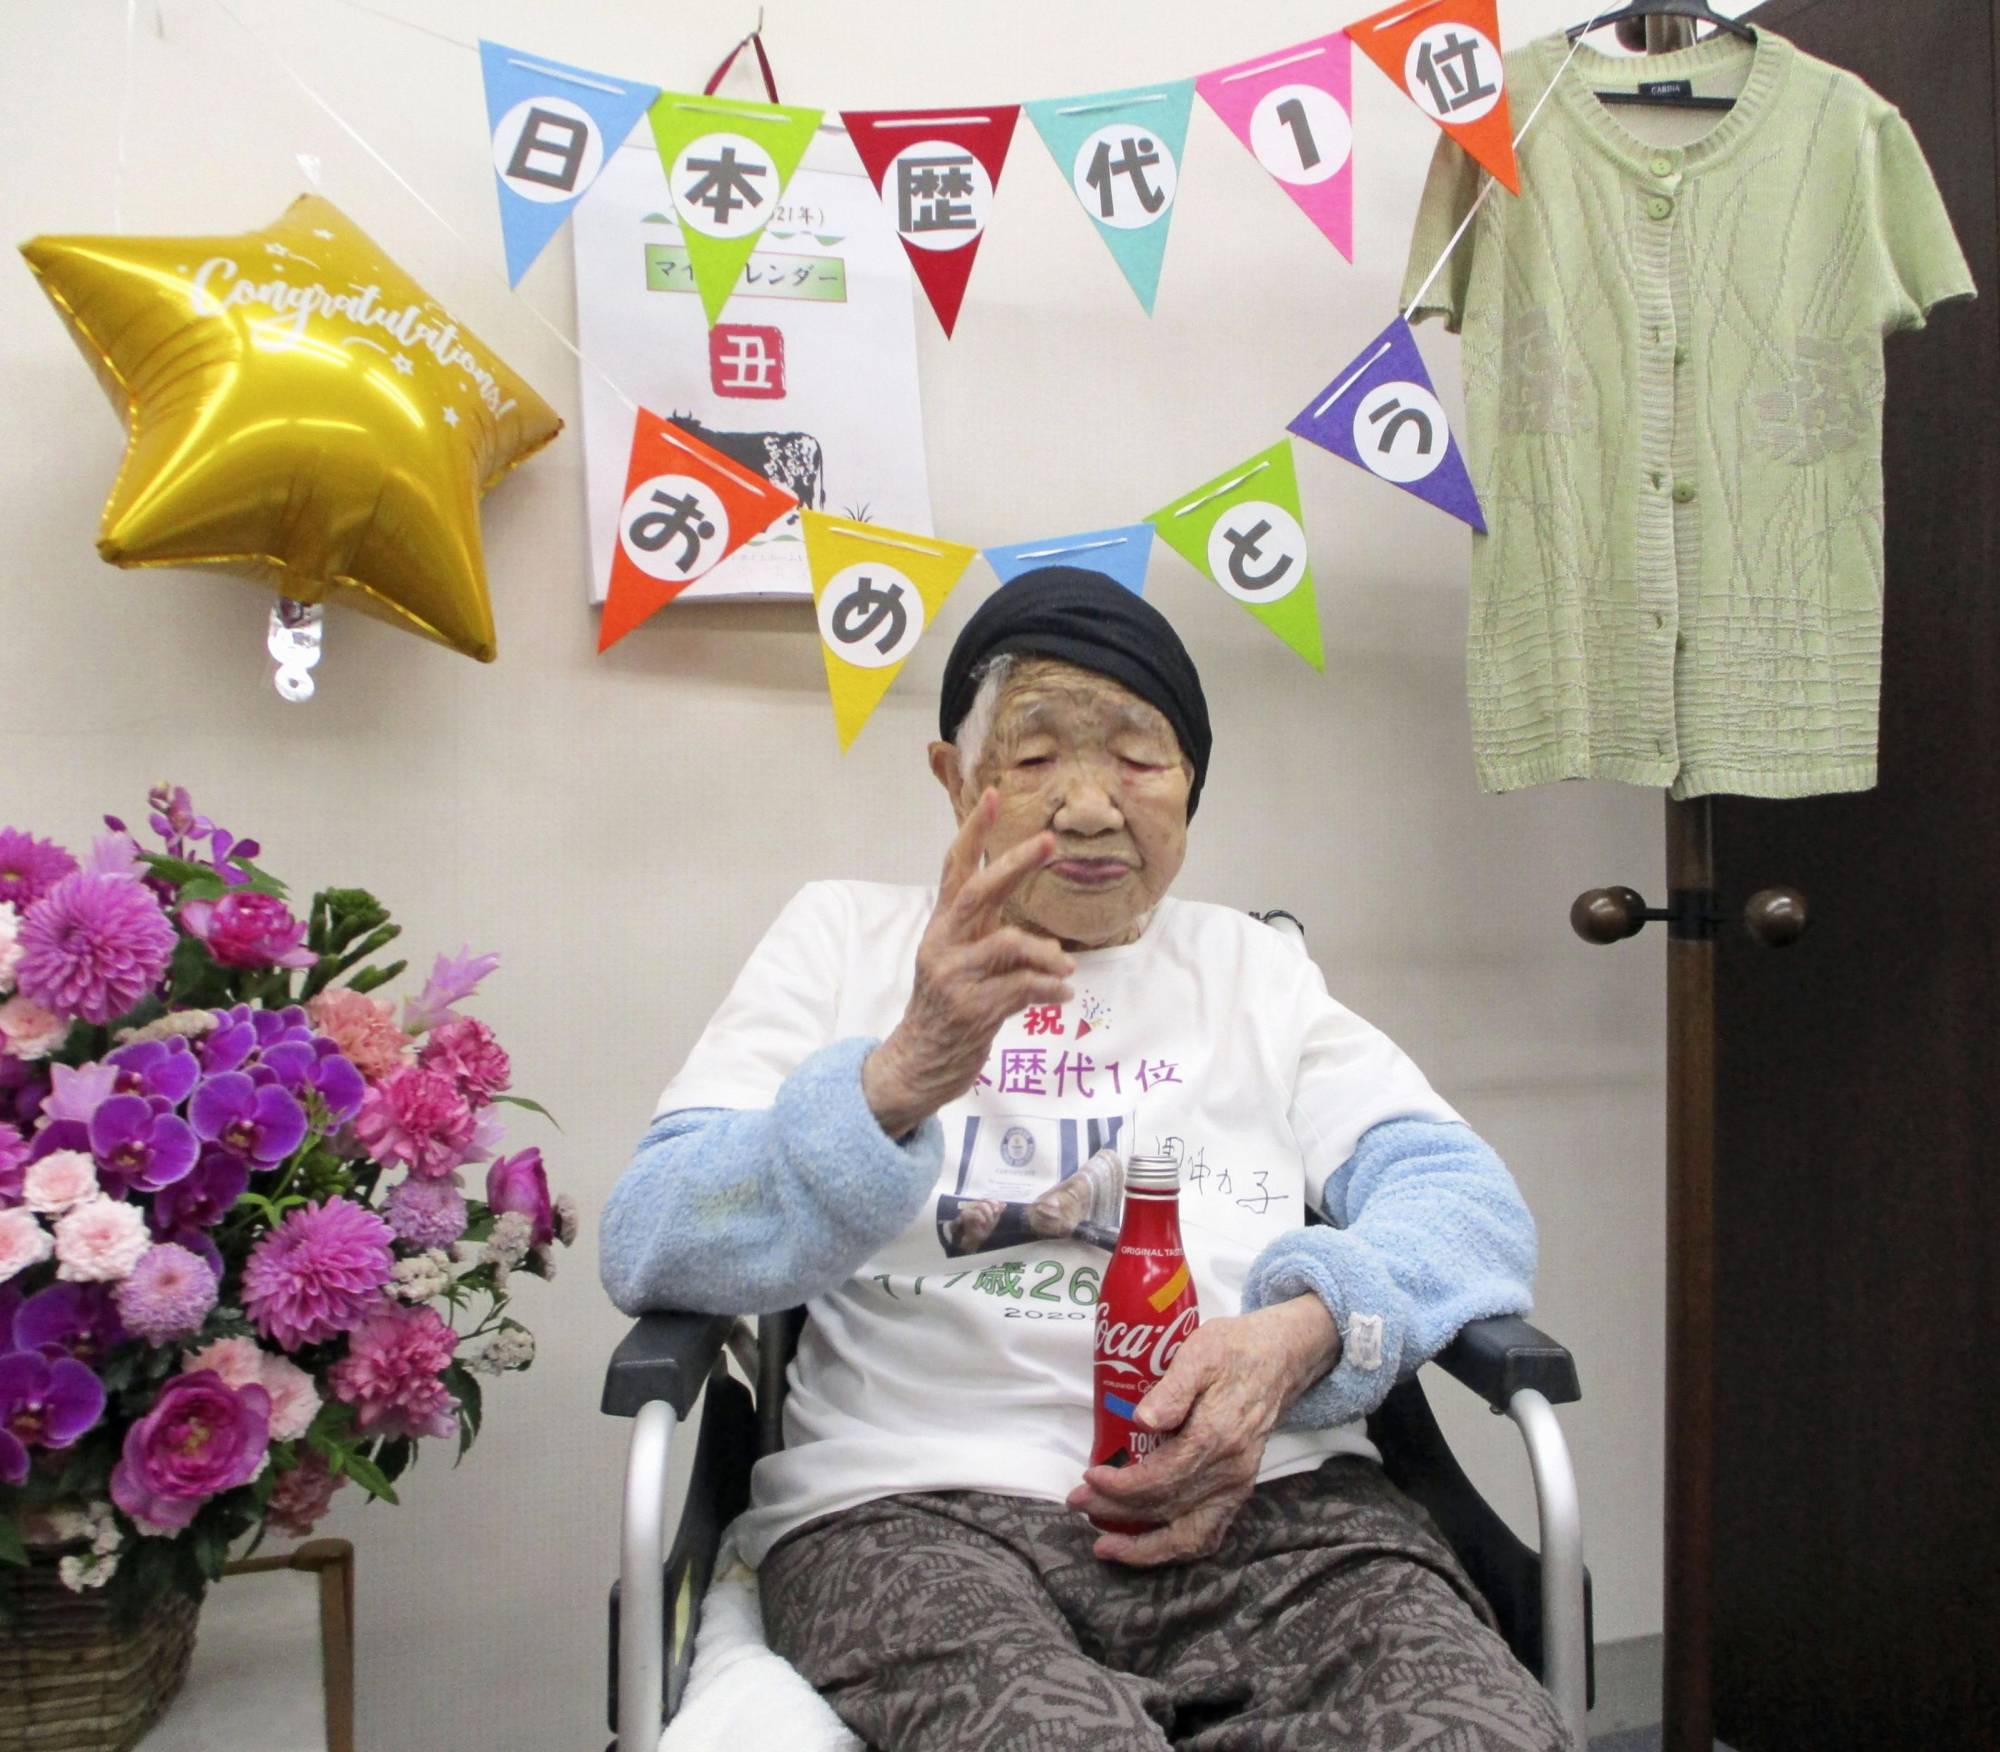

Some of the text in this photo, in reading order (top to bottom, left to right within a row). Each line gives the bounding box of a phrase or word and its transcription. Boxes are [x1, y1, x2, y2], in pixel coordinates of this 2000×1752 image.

[655, 261, 838, 286] マイレンダー
[191, 257, 517, 420] Congratulations!
[720, 335, 776, 388] 丑
[1023, 1004, 1064, 1036] 祝
[974, 1049, 1183, 1098] 歴代1位
[1121, 1246, 1163, 1256] ORIGINAL
